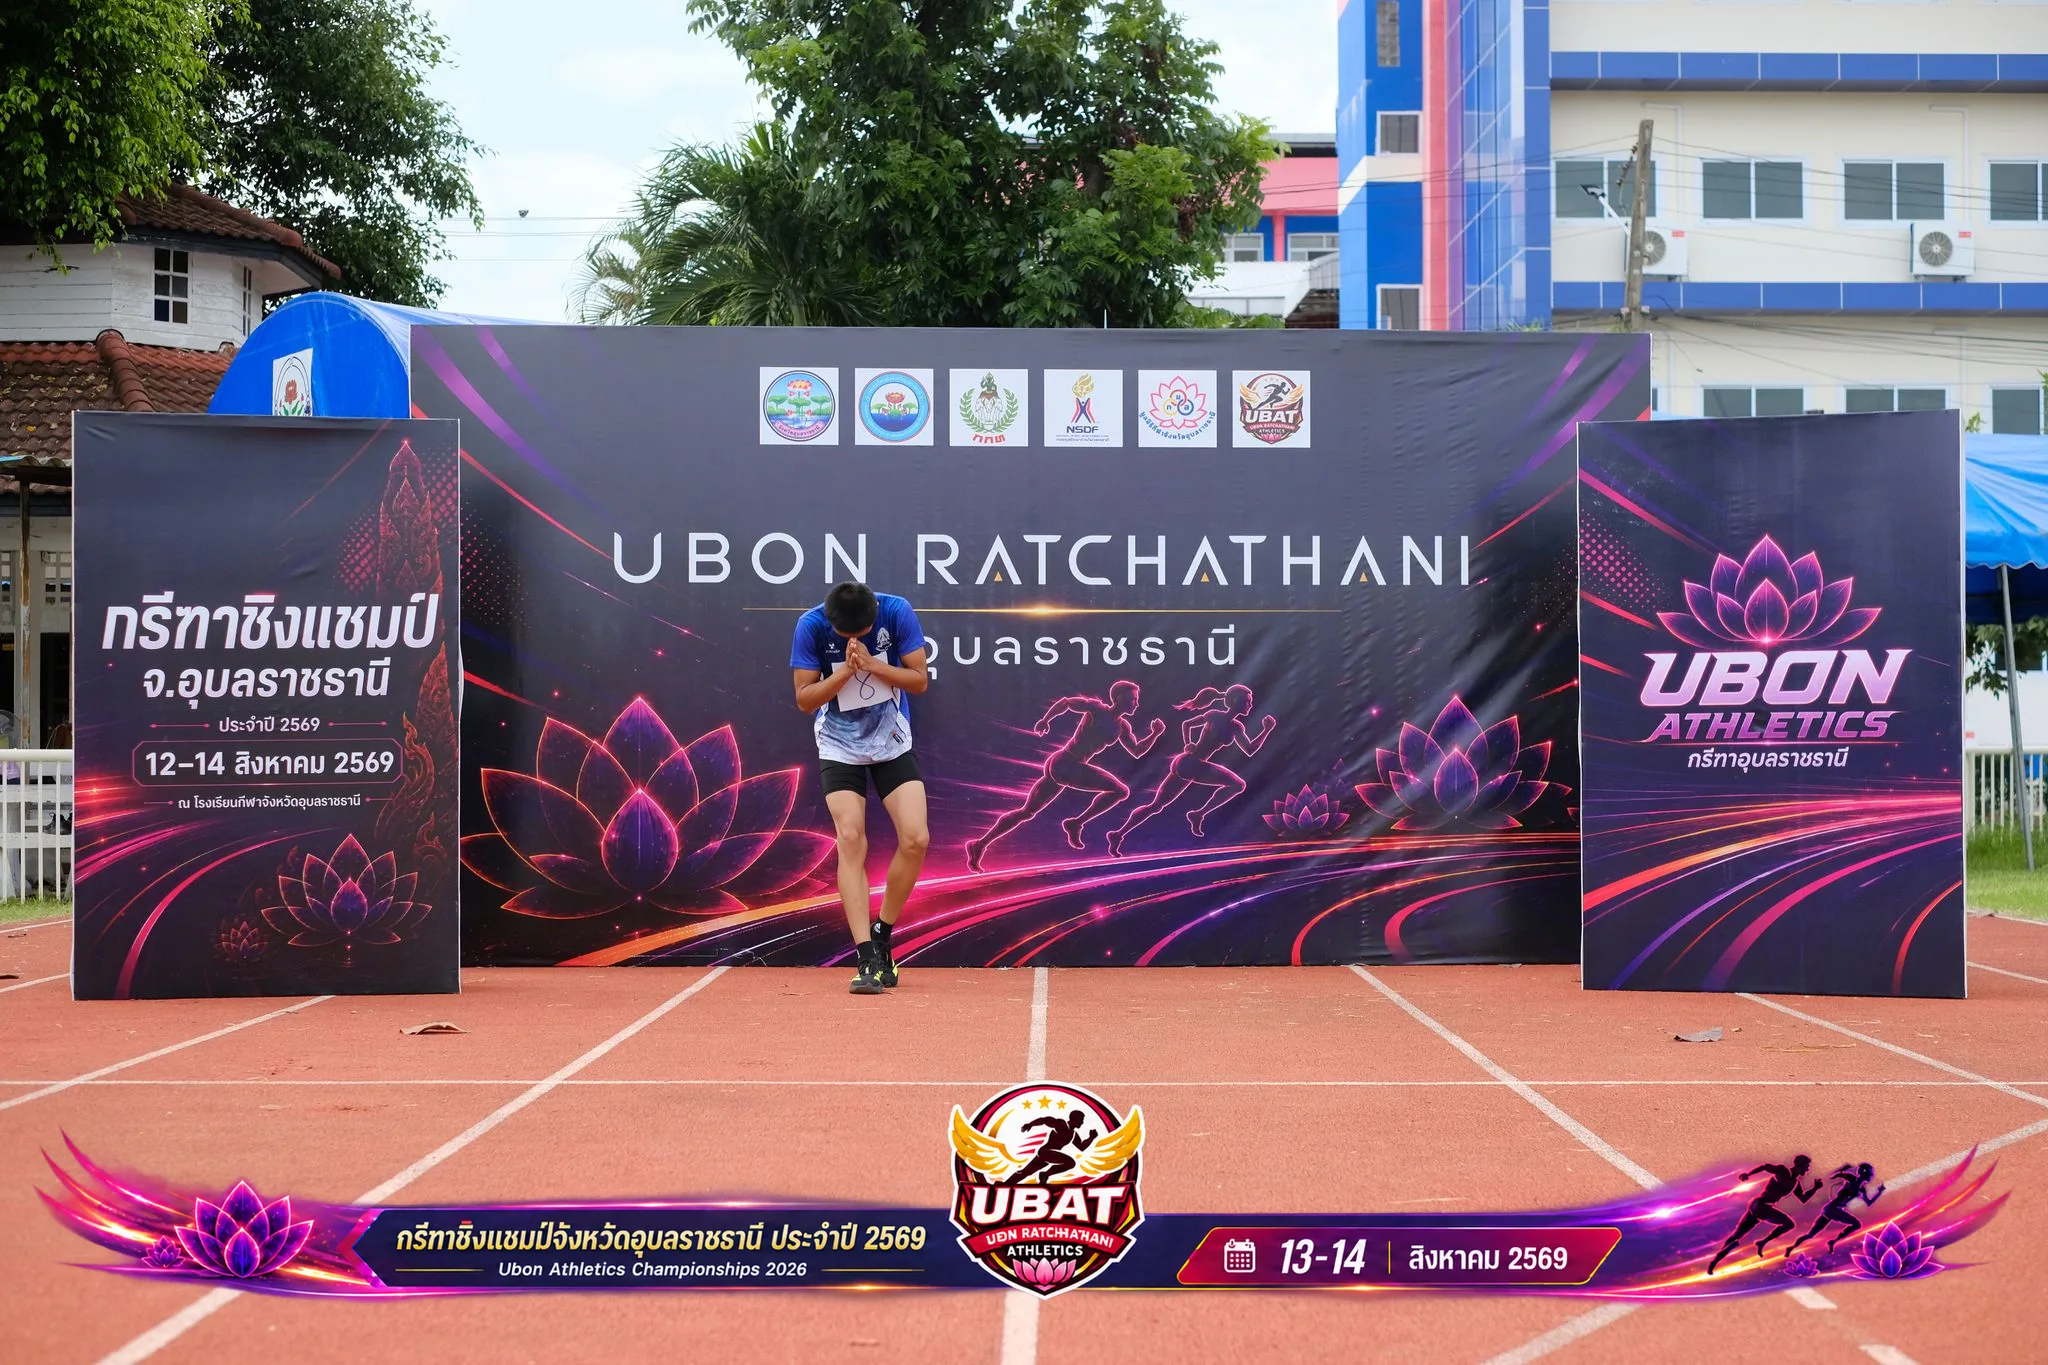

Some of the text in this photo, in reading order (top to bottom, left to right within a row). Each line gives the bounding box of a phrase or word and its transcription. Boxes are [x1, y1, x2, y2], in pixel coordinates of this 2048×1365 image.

[1066, 425, 1099, 434] NSDF
[1245, 409, 1299, 424] UBAT
[613, 532, 1470, 586] UBON RATCHATHANI
[102, 590, 440, 650] กรีฑาชิงแชมป์
[143, 656, 391, 710] จ.อุบลราชธานี
[1640, 649, 1913, 707] UBON
[219, 715, 321, 733] ประจำปี 2569
[1640, 710, 1900, 741] ATHLETICS
[145, 751, 395, 776] 12-14 สิงหาคม 2569
[1687, 746, 1850, 774] กรีฑาอุบลราชธานี
[178, 793, 361, 811] ณ โรงเรียนกีฬาจังหวัดอุบลราชธานี
